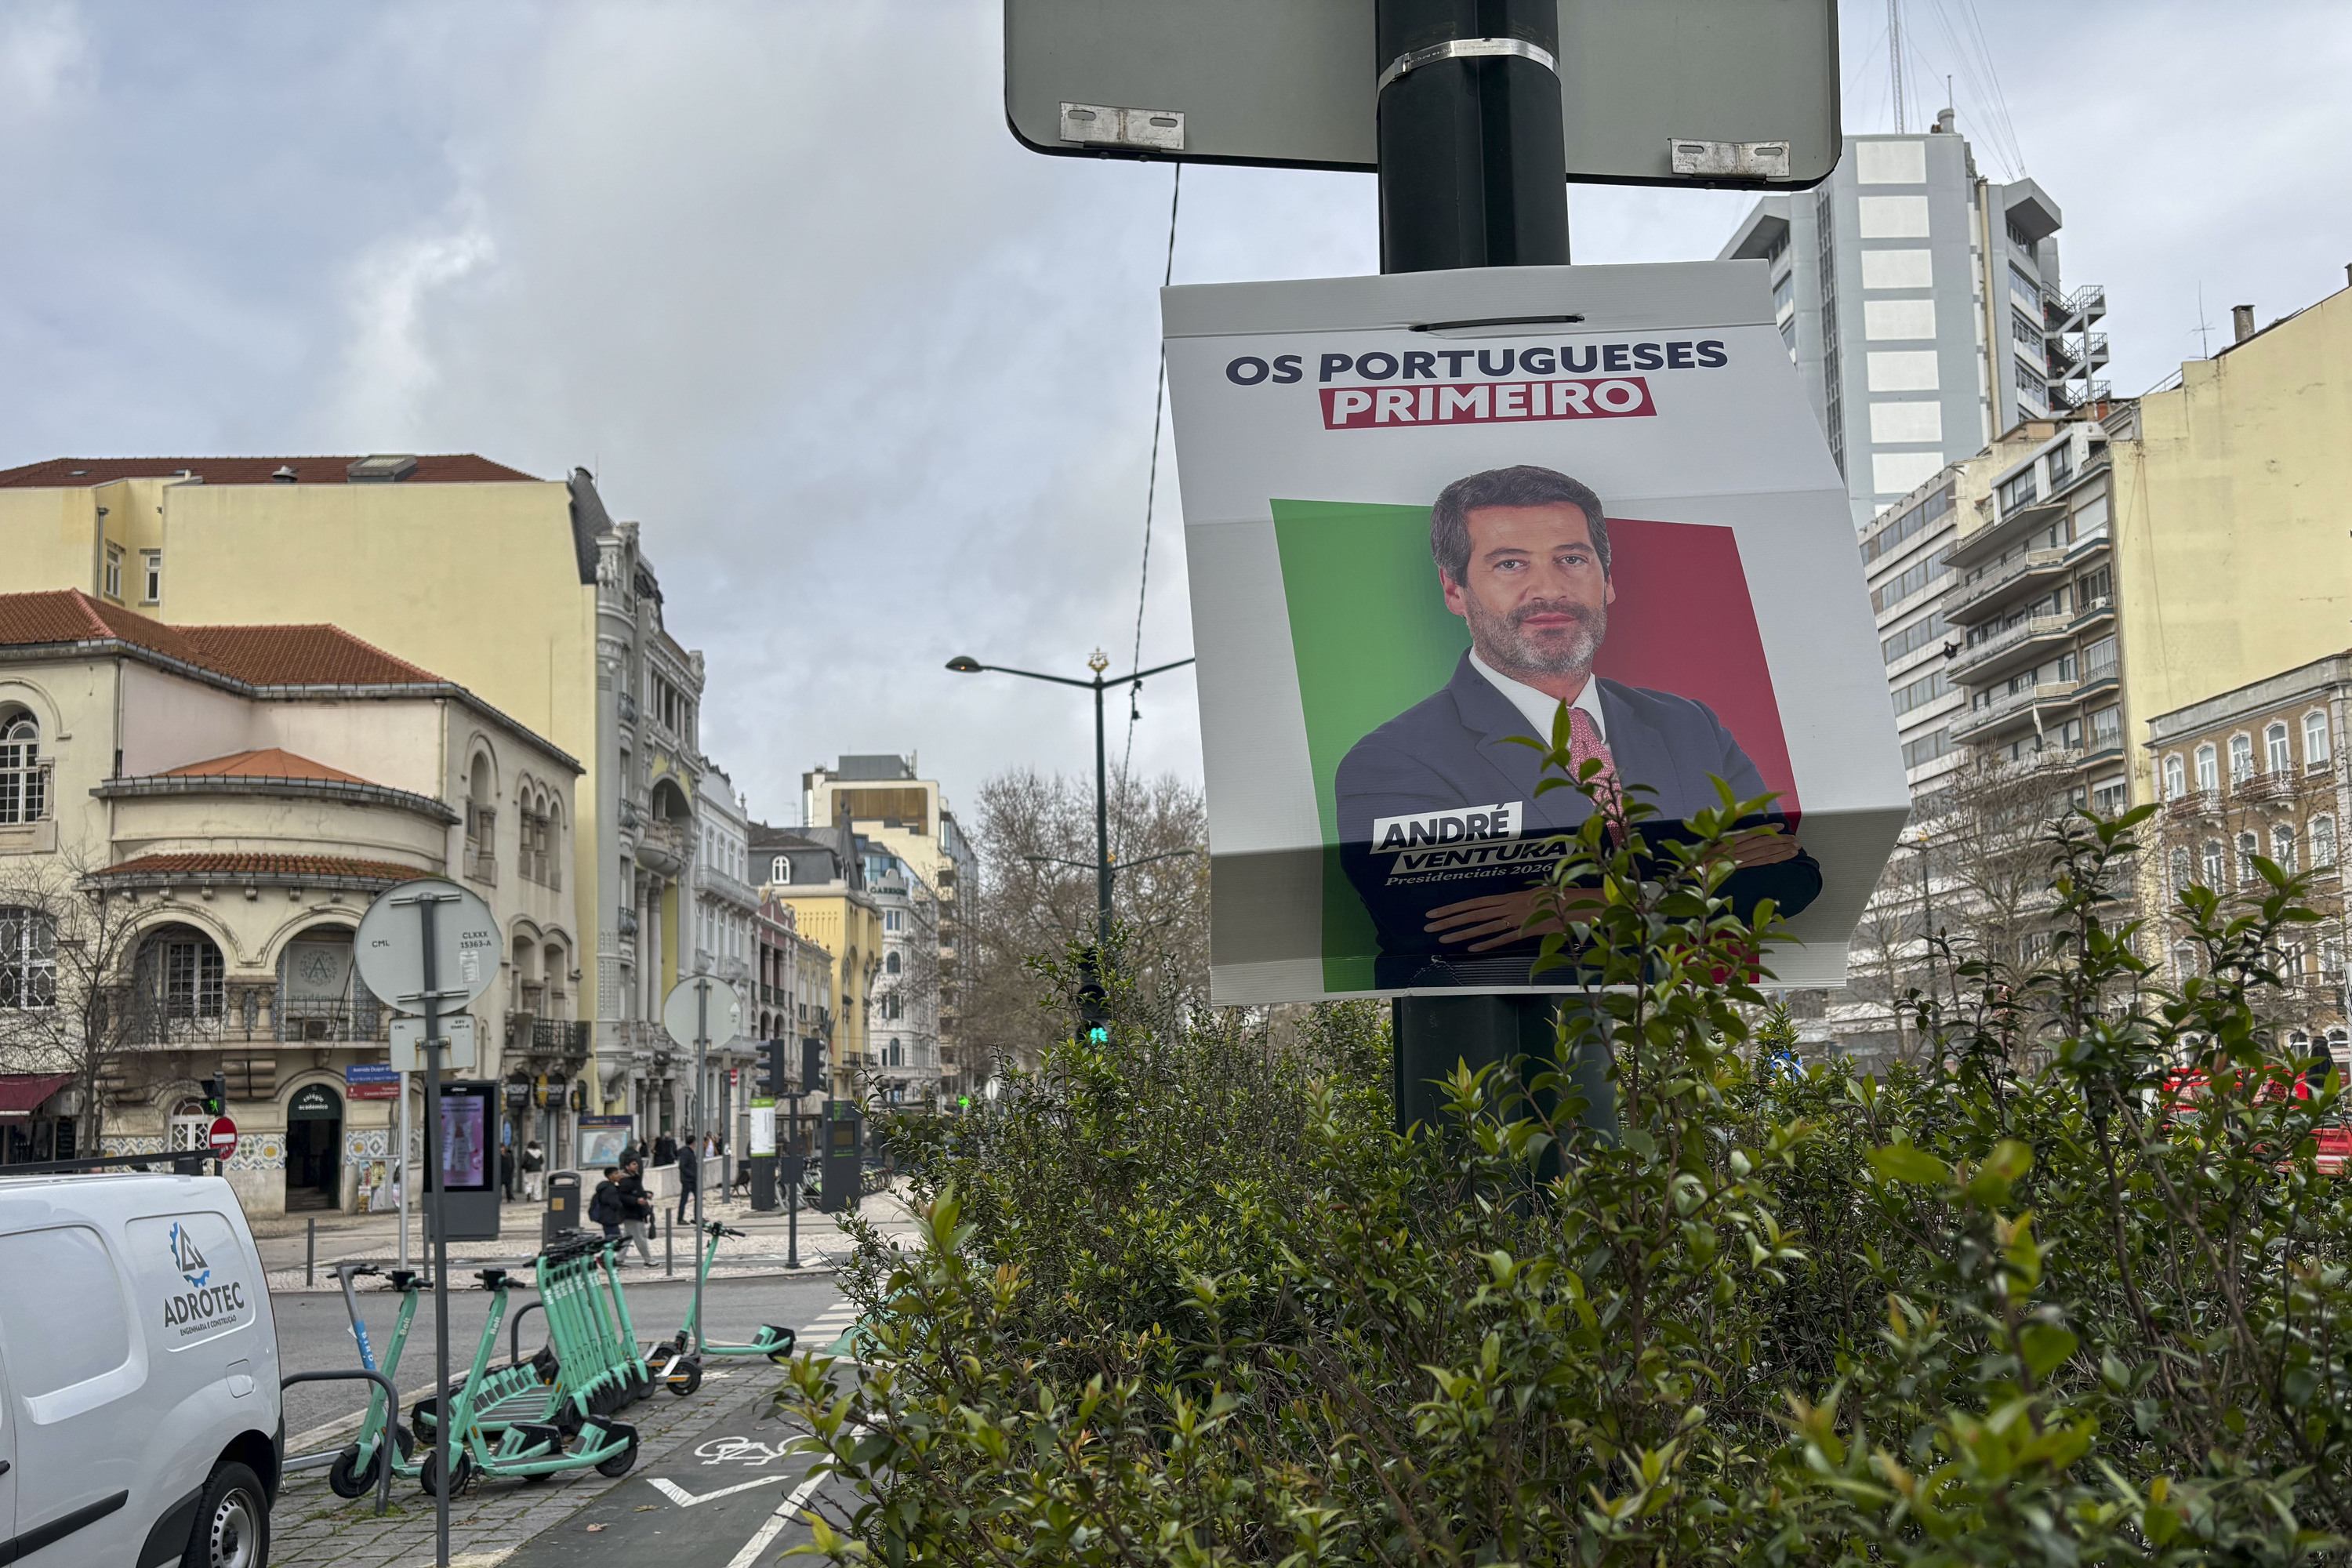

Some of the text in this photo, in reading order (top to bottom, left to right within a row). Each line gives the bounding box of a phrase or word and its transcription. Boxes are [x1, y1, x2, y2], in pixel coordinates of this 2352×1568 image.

[1225, 339, 1728, 386] OS PORTUGUESES
[1332, 379, 1644, 425] PRIMEIRO
[1377, 802, 1509, 851] ANDRÉ
[1385, 862, 1554, 887] Presidenciais 2026
[1403, 840, 1569, 870] VENTURA
[164, 1281, 245, 1328] ADROTEC
[180, 1323, 208, 1337] ENGENHARIA
[211, 1314, 237, 1328] CONSTRUÇÃO
